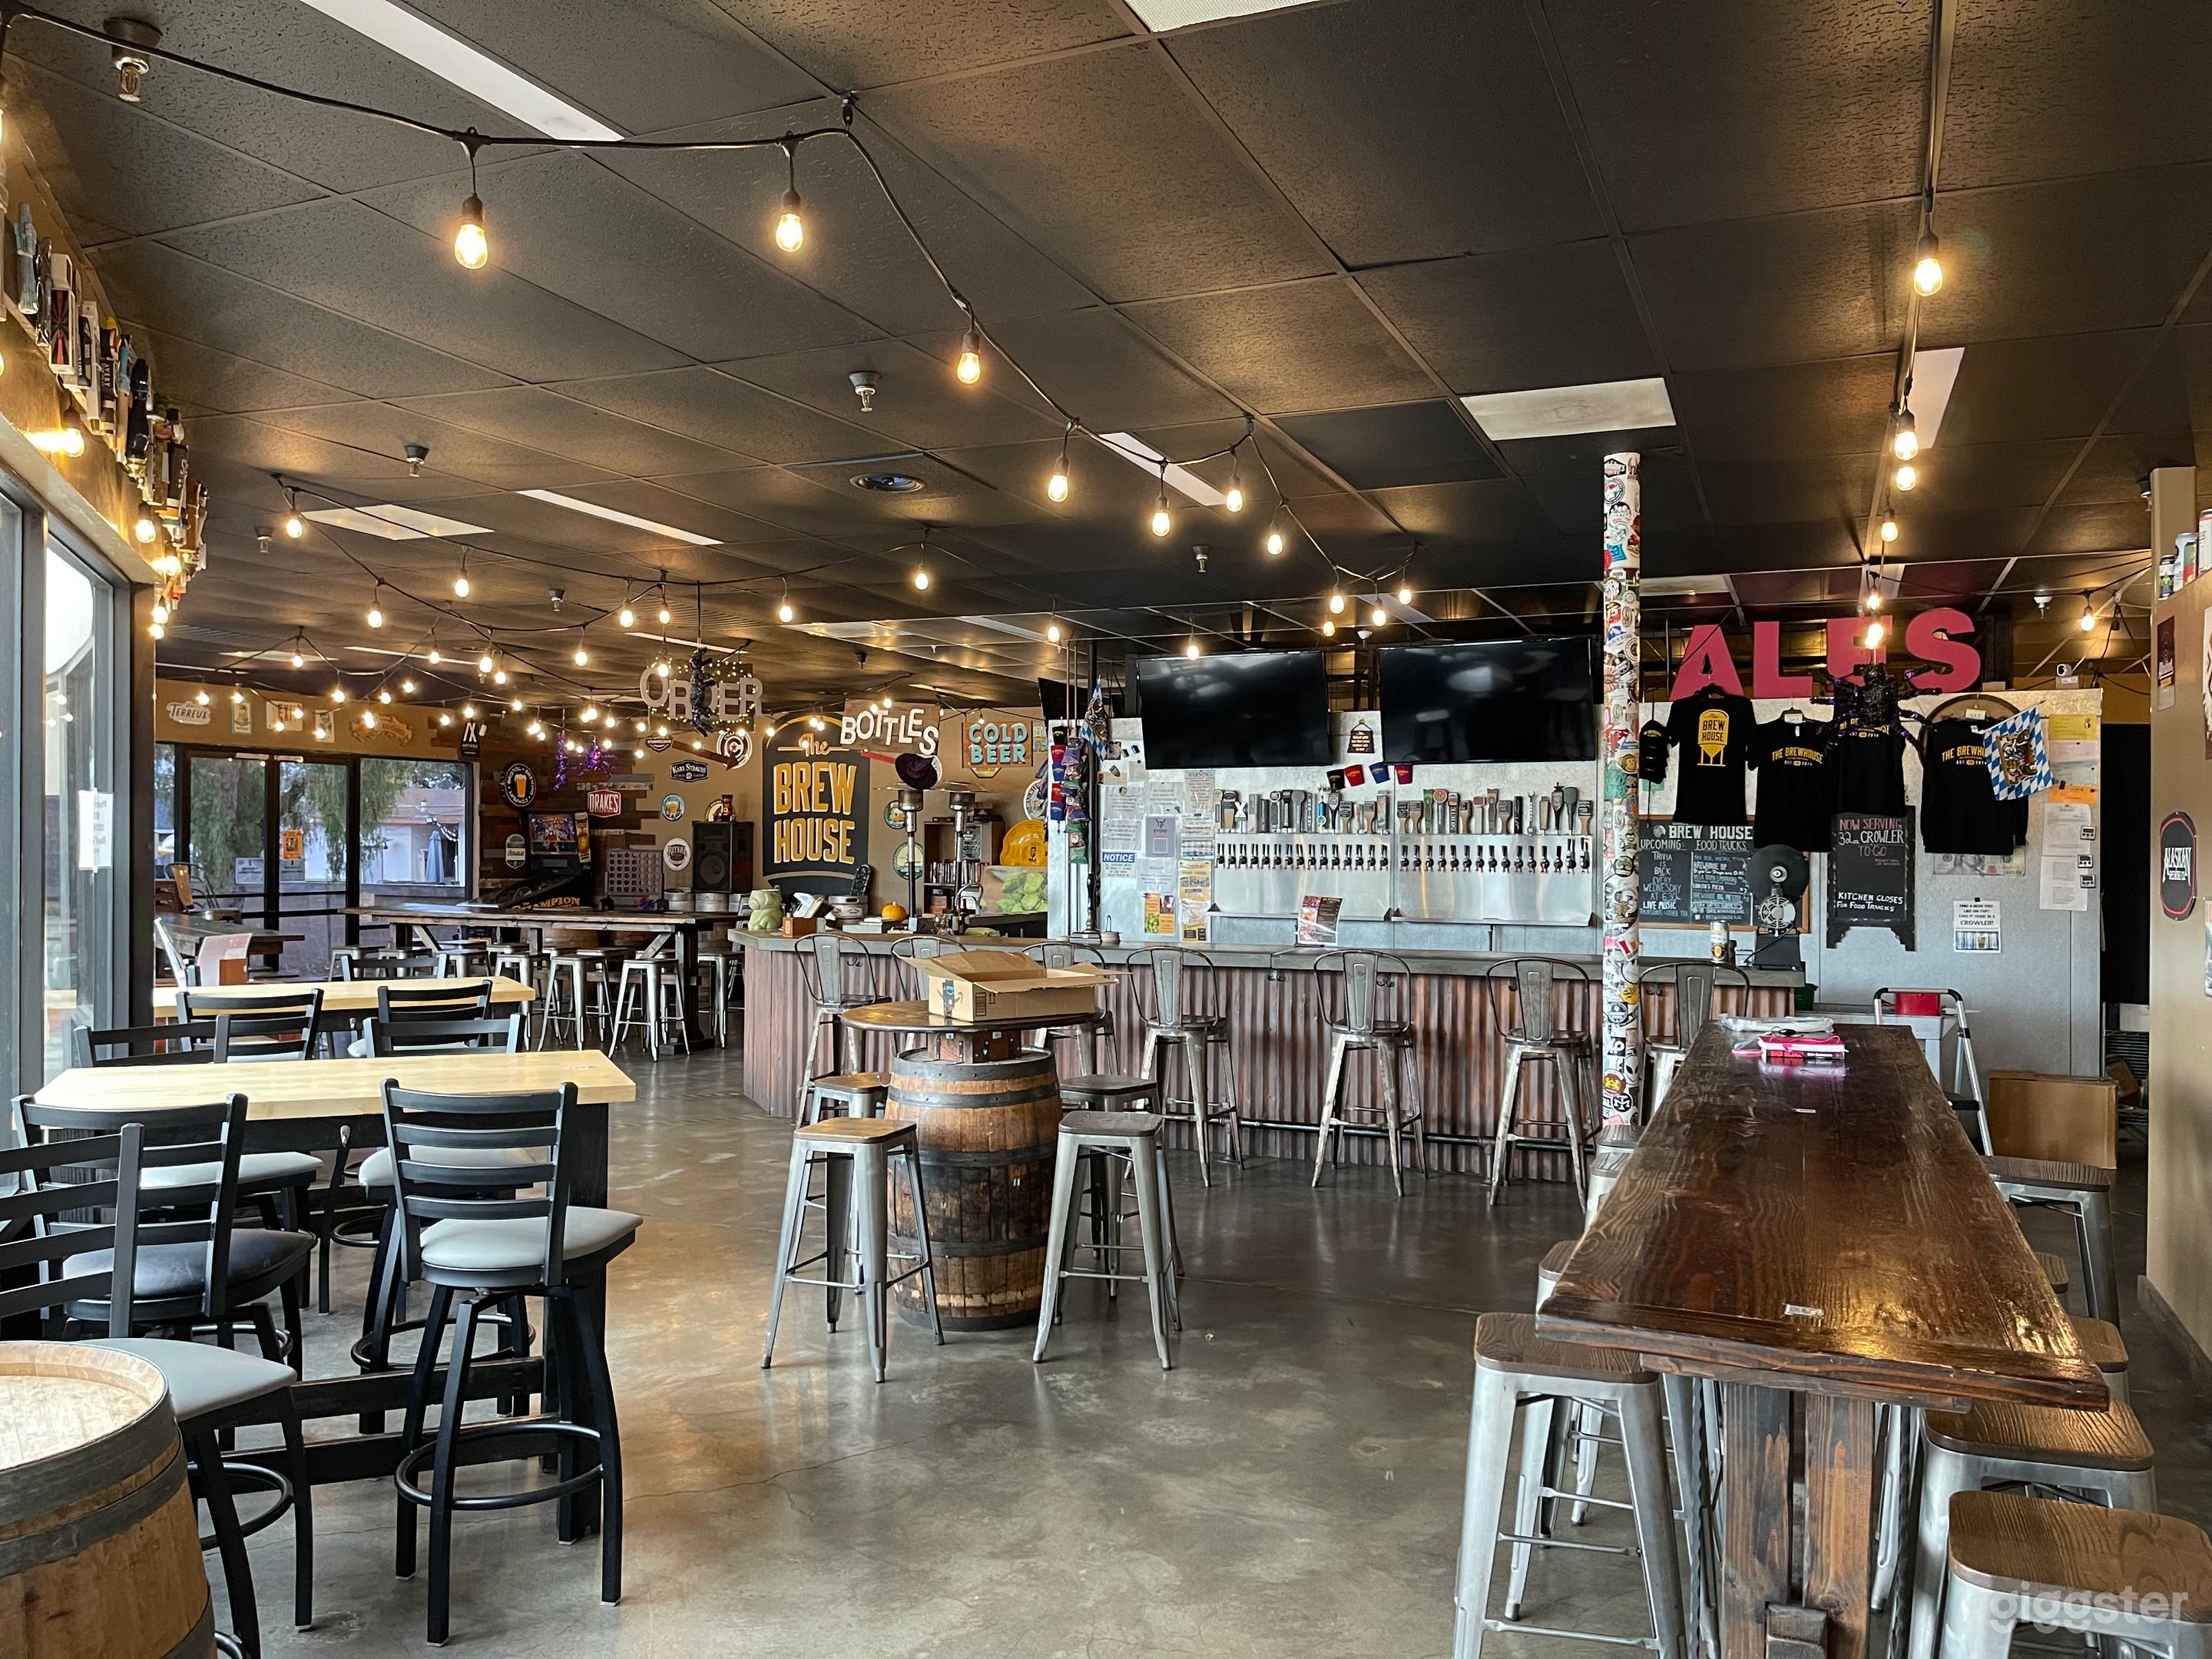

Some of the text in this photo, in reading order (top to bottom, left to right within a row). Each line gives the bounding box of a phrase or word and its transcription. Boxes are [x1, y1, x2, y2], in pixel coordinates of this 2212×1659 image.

[1671, 607, 1982, 697] ALES
[170, 704, 208, 720] TERREUX
[840, 708, 940, 755] BOTTLES
[1703, 720, 1725, 731] BREW
[969, 722, 1028, 744] COLD
[1702, 732, 1724, 742] HOUSE
[799, 733, 830, 757] The
[969, 743, 1027, 764] BEER
[1772, 747, 1824, 764] THE BREWHOUSE
[1942, 745, 1986, 762] THE BREWH
[773, 761, 857, 816] BREW
[1839, 818, 1902, 830] NOW SERVING
[1668, 825, 1753, 840] BREW HOUSE
[1859, 830, 1905, 844] CROWLER
[773, 817, 856, 865] HOUSE
[1696, 839, 1747, 851] FOOD TRUCKS
[1103, 853, 1134, 862] NOTICE
[1651, 851, 1673, 861] TRIVIA
[1654, 866, 1671, 876] BACK
[2162, 847, 2192, 886] ALASKAN
[1652, 876, 1672, 885] EVERY
[1643, 882, 1682, 894] WEDNESDAY
[1650, 892, 1659, 901] AT
[1838, 892, 1903, 905] KITCHEN CLOSES
[1643, 901, 1677, 910] LIVE MUSIC
[1849, 901, 1866, 910] FOOD
[1866, 901, 1895, 912] TRUCKS
